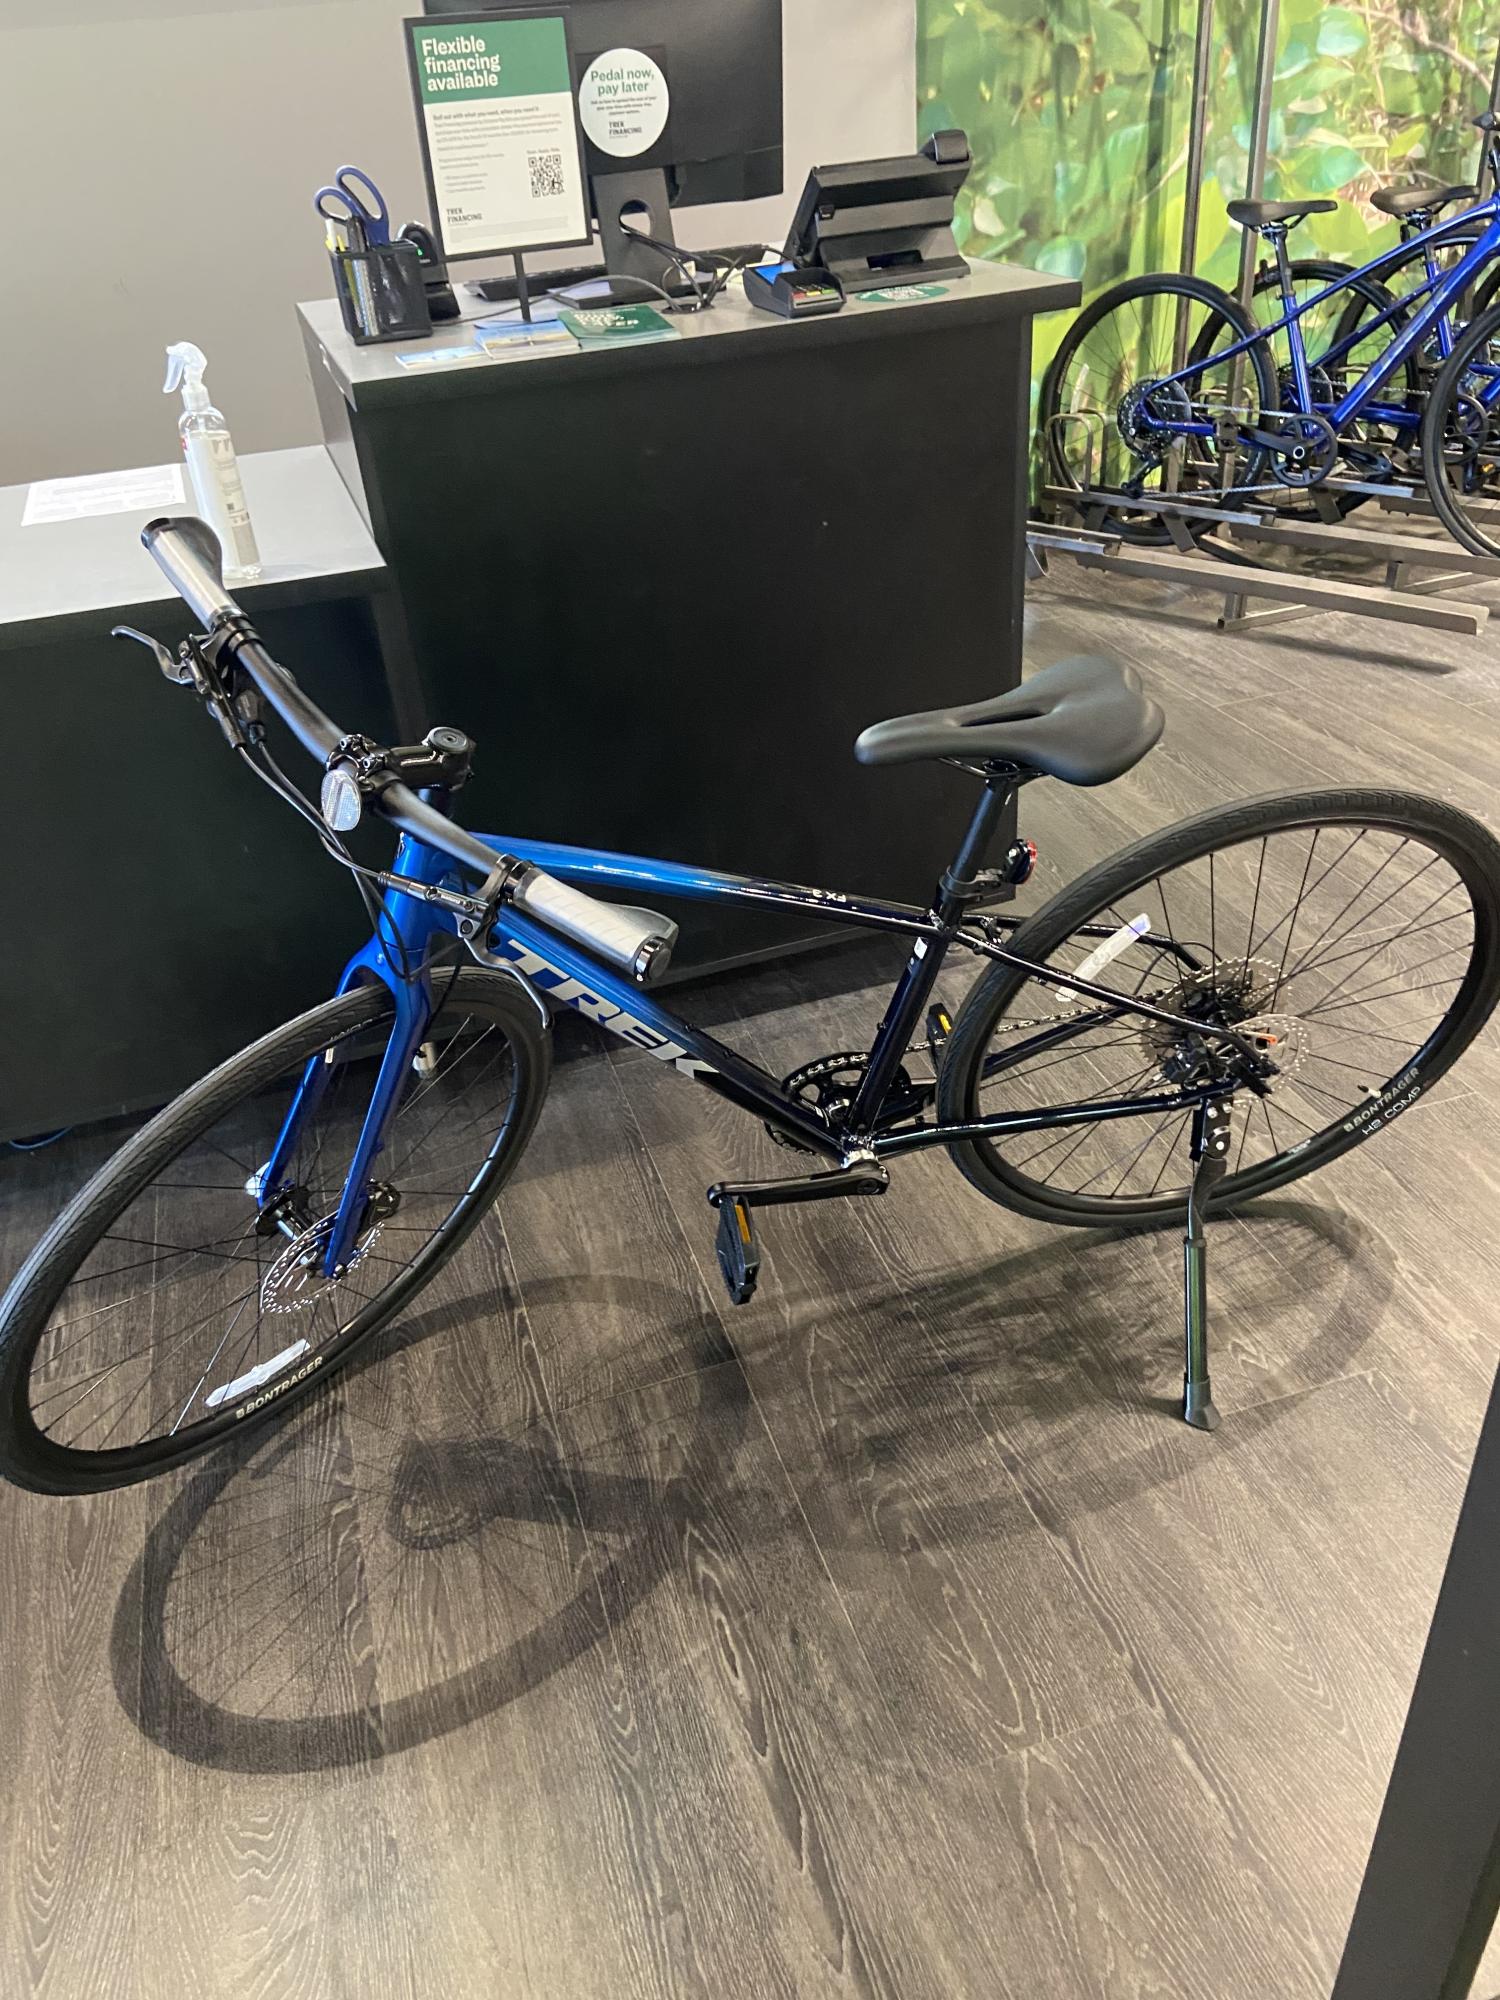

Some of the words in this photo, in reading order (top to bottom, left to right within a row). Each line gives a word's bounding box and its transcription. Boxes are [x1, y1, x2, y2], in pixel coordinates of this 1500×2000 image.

[421, 35, 486, 56] Flexible
[424, 53, 501, 73] financing
[427, 70, 499, 92] available
[590, 68, 624, 82] Pedal
[626, 69, 655, 80] now,
[597, 84, 619, 97] pay
[621, 82, 649, 93] later
[608, 121, 624, 129] TREK
[608, 127, 642, 136] FINANCING
[446, 207, 463, 216] TREK
[447, 213, 482, 223] FINANCING
[508, 938, 720, 1079] TREK
[1353, 1067, 1420, 1127] BONTRAGER
[1384, 1086, 1421, 1119] COMP
[244, 1356, 323, 1415] BONTRAGER
